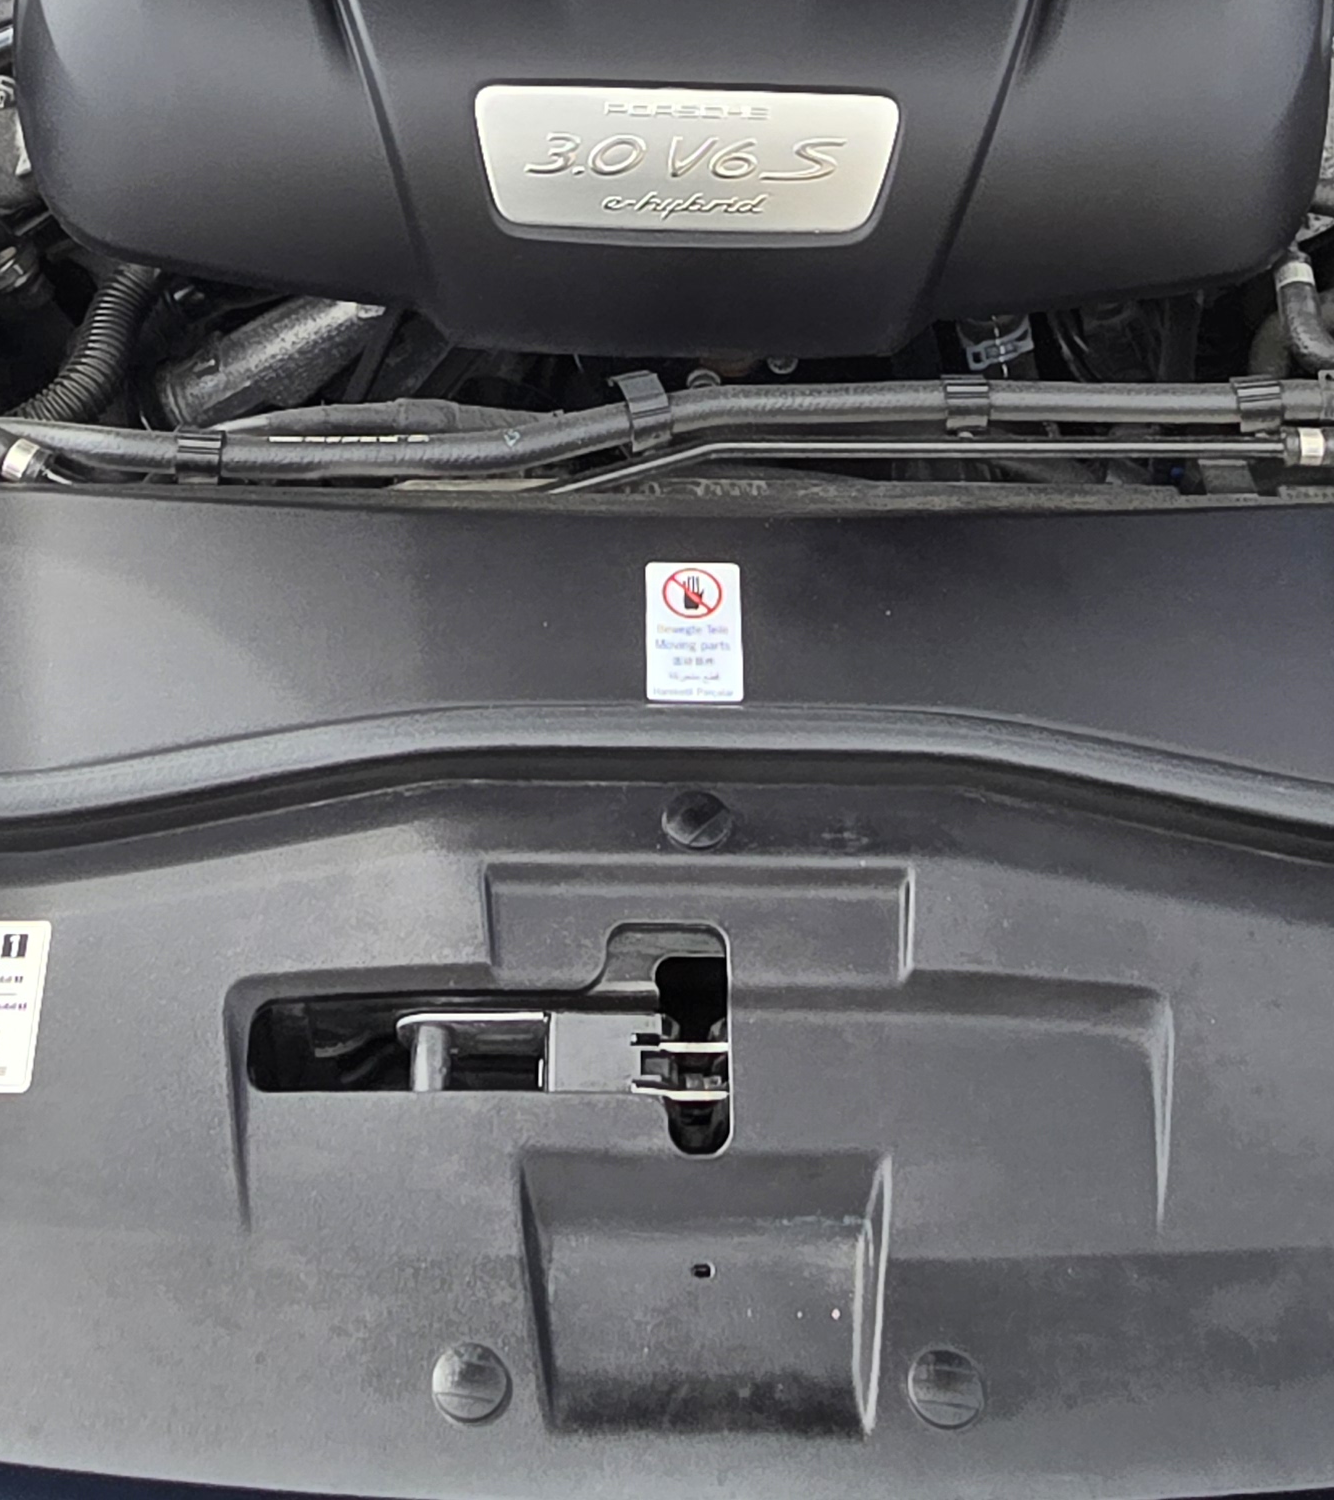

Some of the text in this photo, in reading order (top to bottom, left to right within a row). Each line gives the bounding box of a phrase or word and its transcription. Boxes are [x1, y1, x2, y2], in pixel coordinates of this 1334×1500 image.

[603, 100, 772, 121] PORSCHE
[524, 131, 848, 182] 3.0 V6 S
[601, 190, 770, 220] e-hybrid
[655, 639, 731, 652] Moving parts
